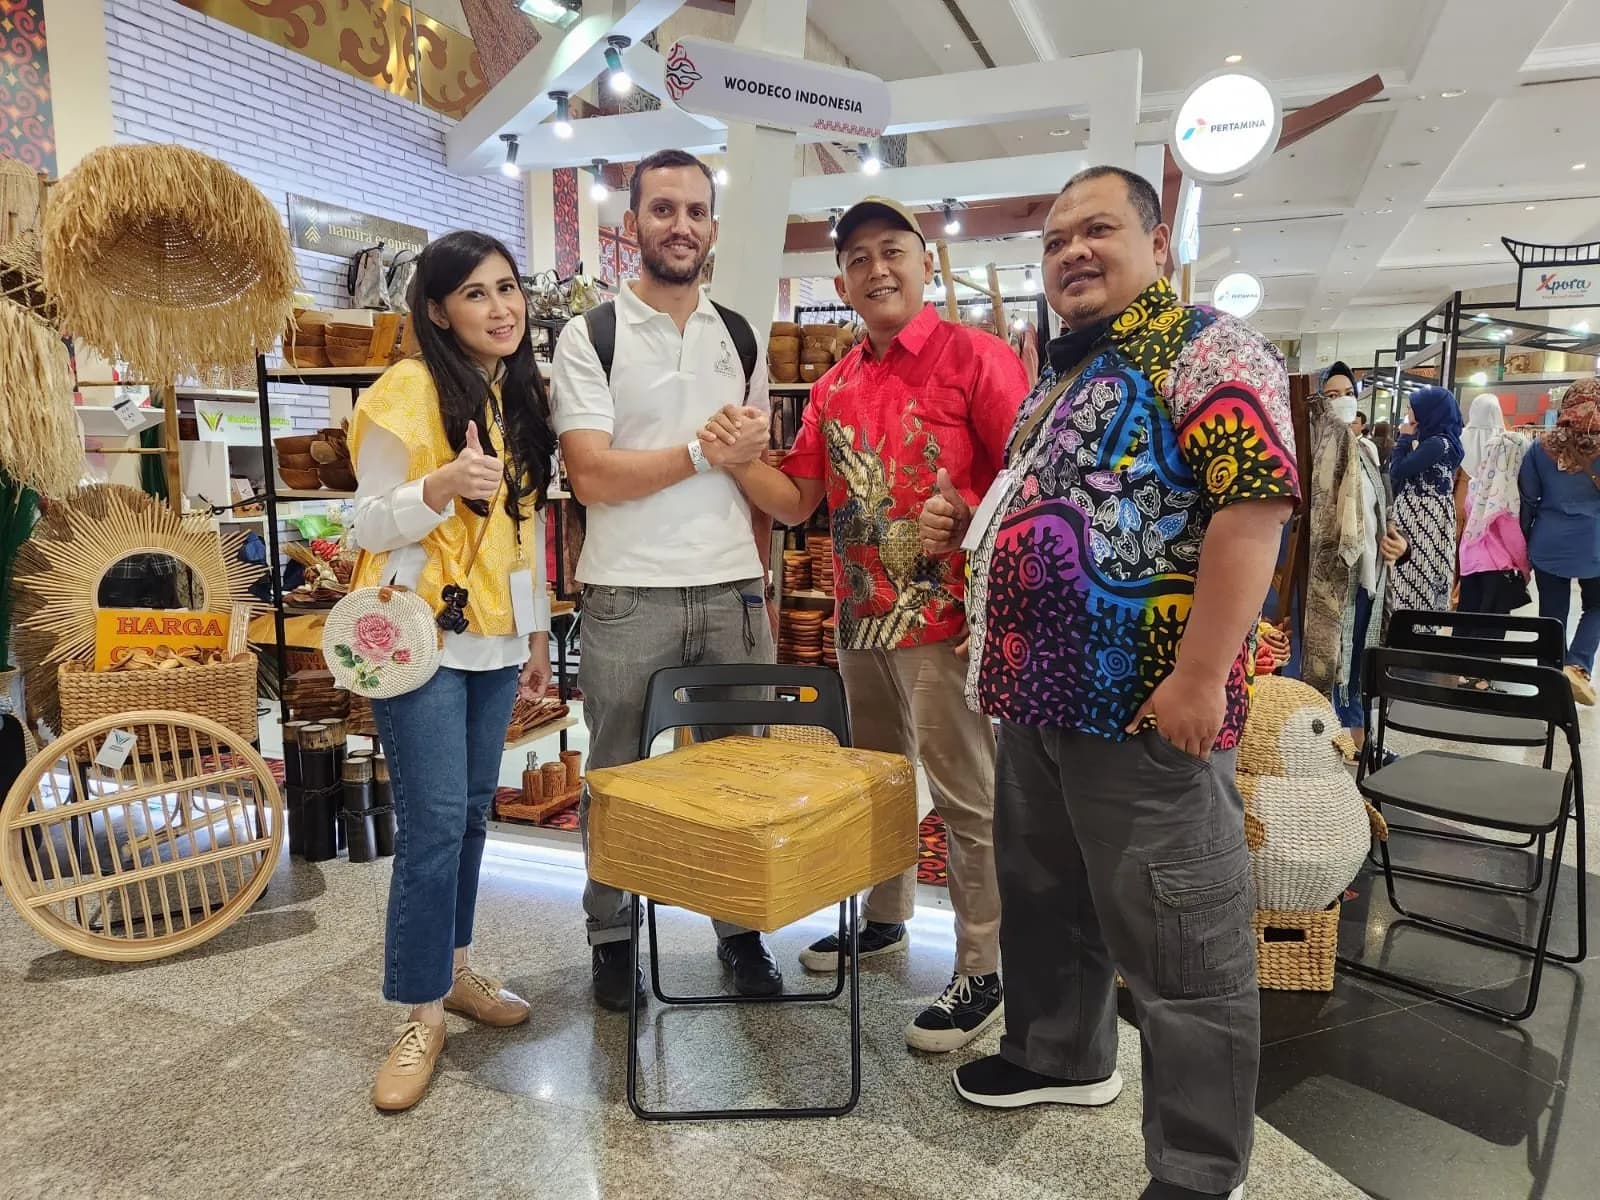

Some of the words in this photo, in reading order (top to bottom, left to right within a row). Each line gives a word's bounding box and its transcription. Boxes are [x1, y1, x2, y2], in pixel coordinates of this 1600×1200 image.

[724, 75, 791, 100] WOODECO
[795, 89, 863, 114] INDONESIA
[1210, 119, 1266, 133] PERTAMINA
[327, 223, 372, 243] namira
[1536, 273, 1592, 295] Xpora
[116, 616, 224, 637] HARGA
